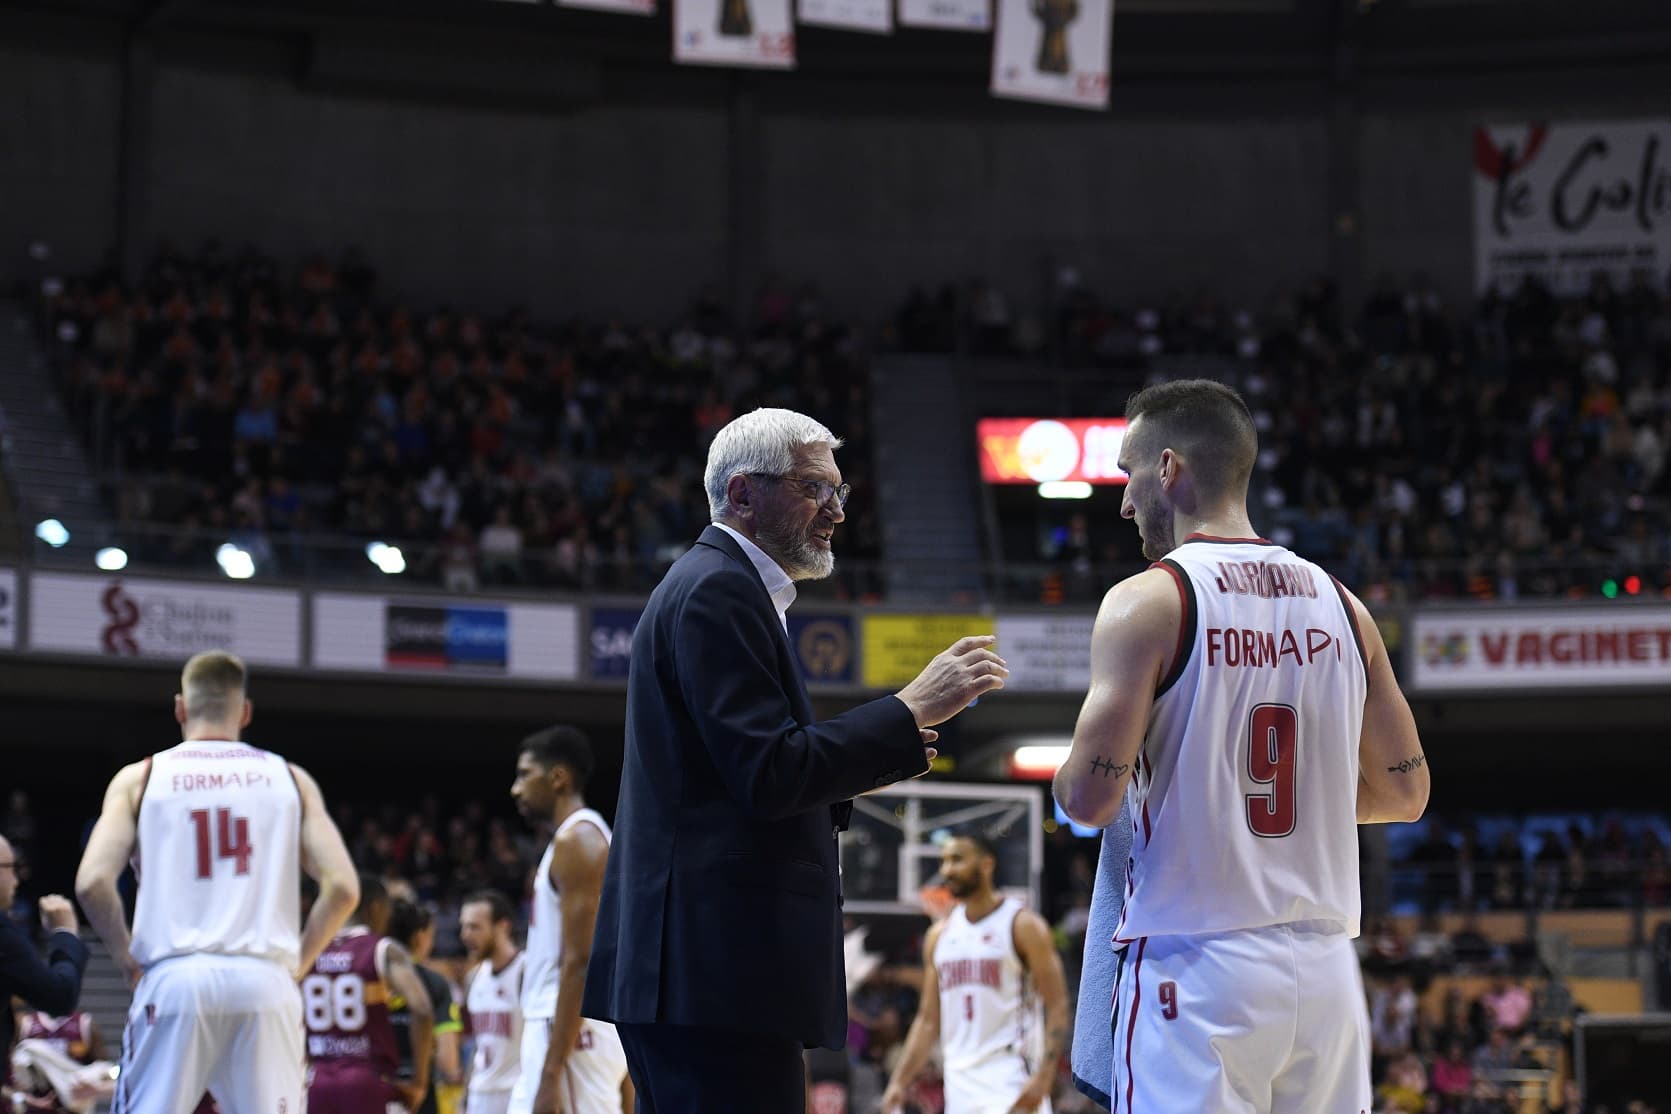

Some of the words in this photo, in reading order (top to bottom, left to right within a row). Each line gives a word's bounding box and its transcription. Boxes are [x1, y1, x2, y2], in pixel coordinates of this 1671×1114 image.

[1245, 703, 1299, 838] 9
[187, 806, 254, 880] 14
[302, 973, 368, 1032] 88
[1158, 980, 1179, 1021] 9
